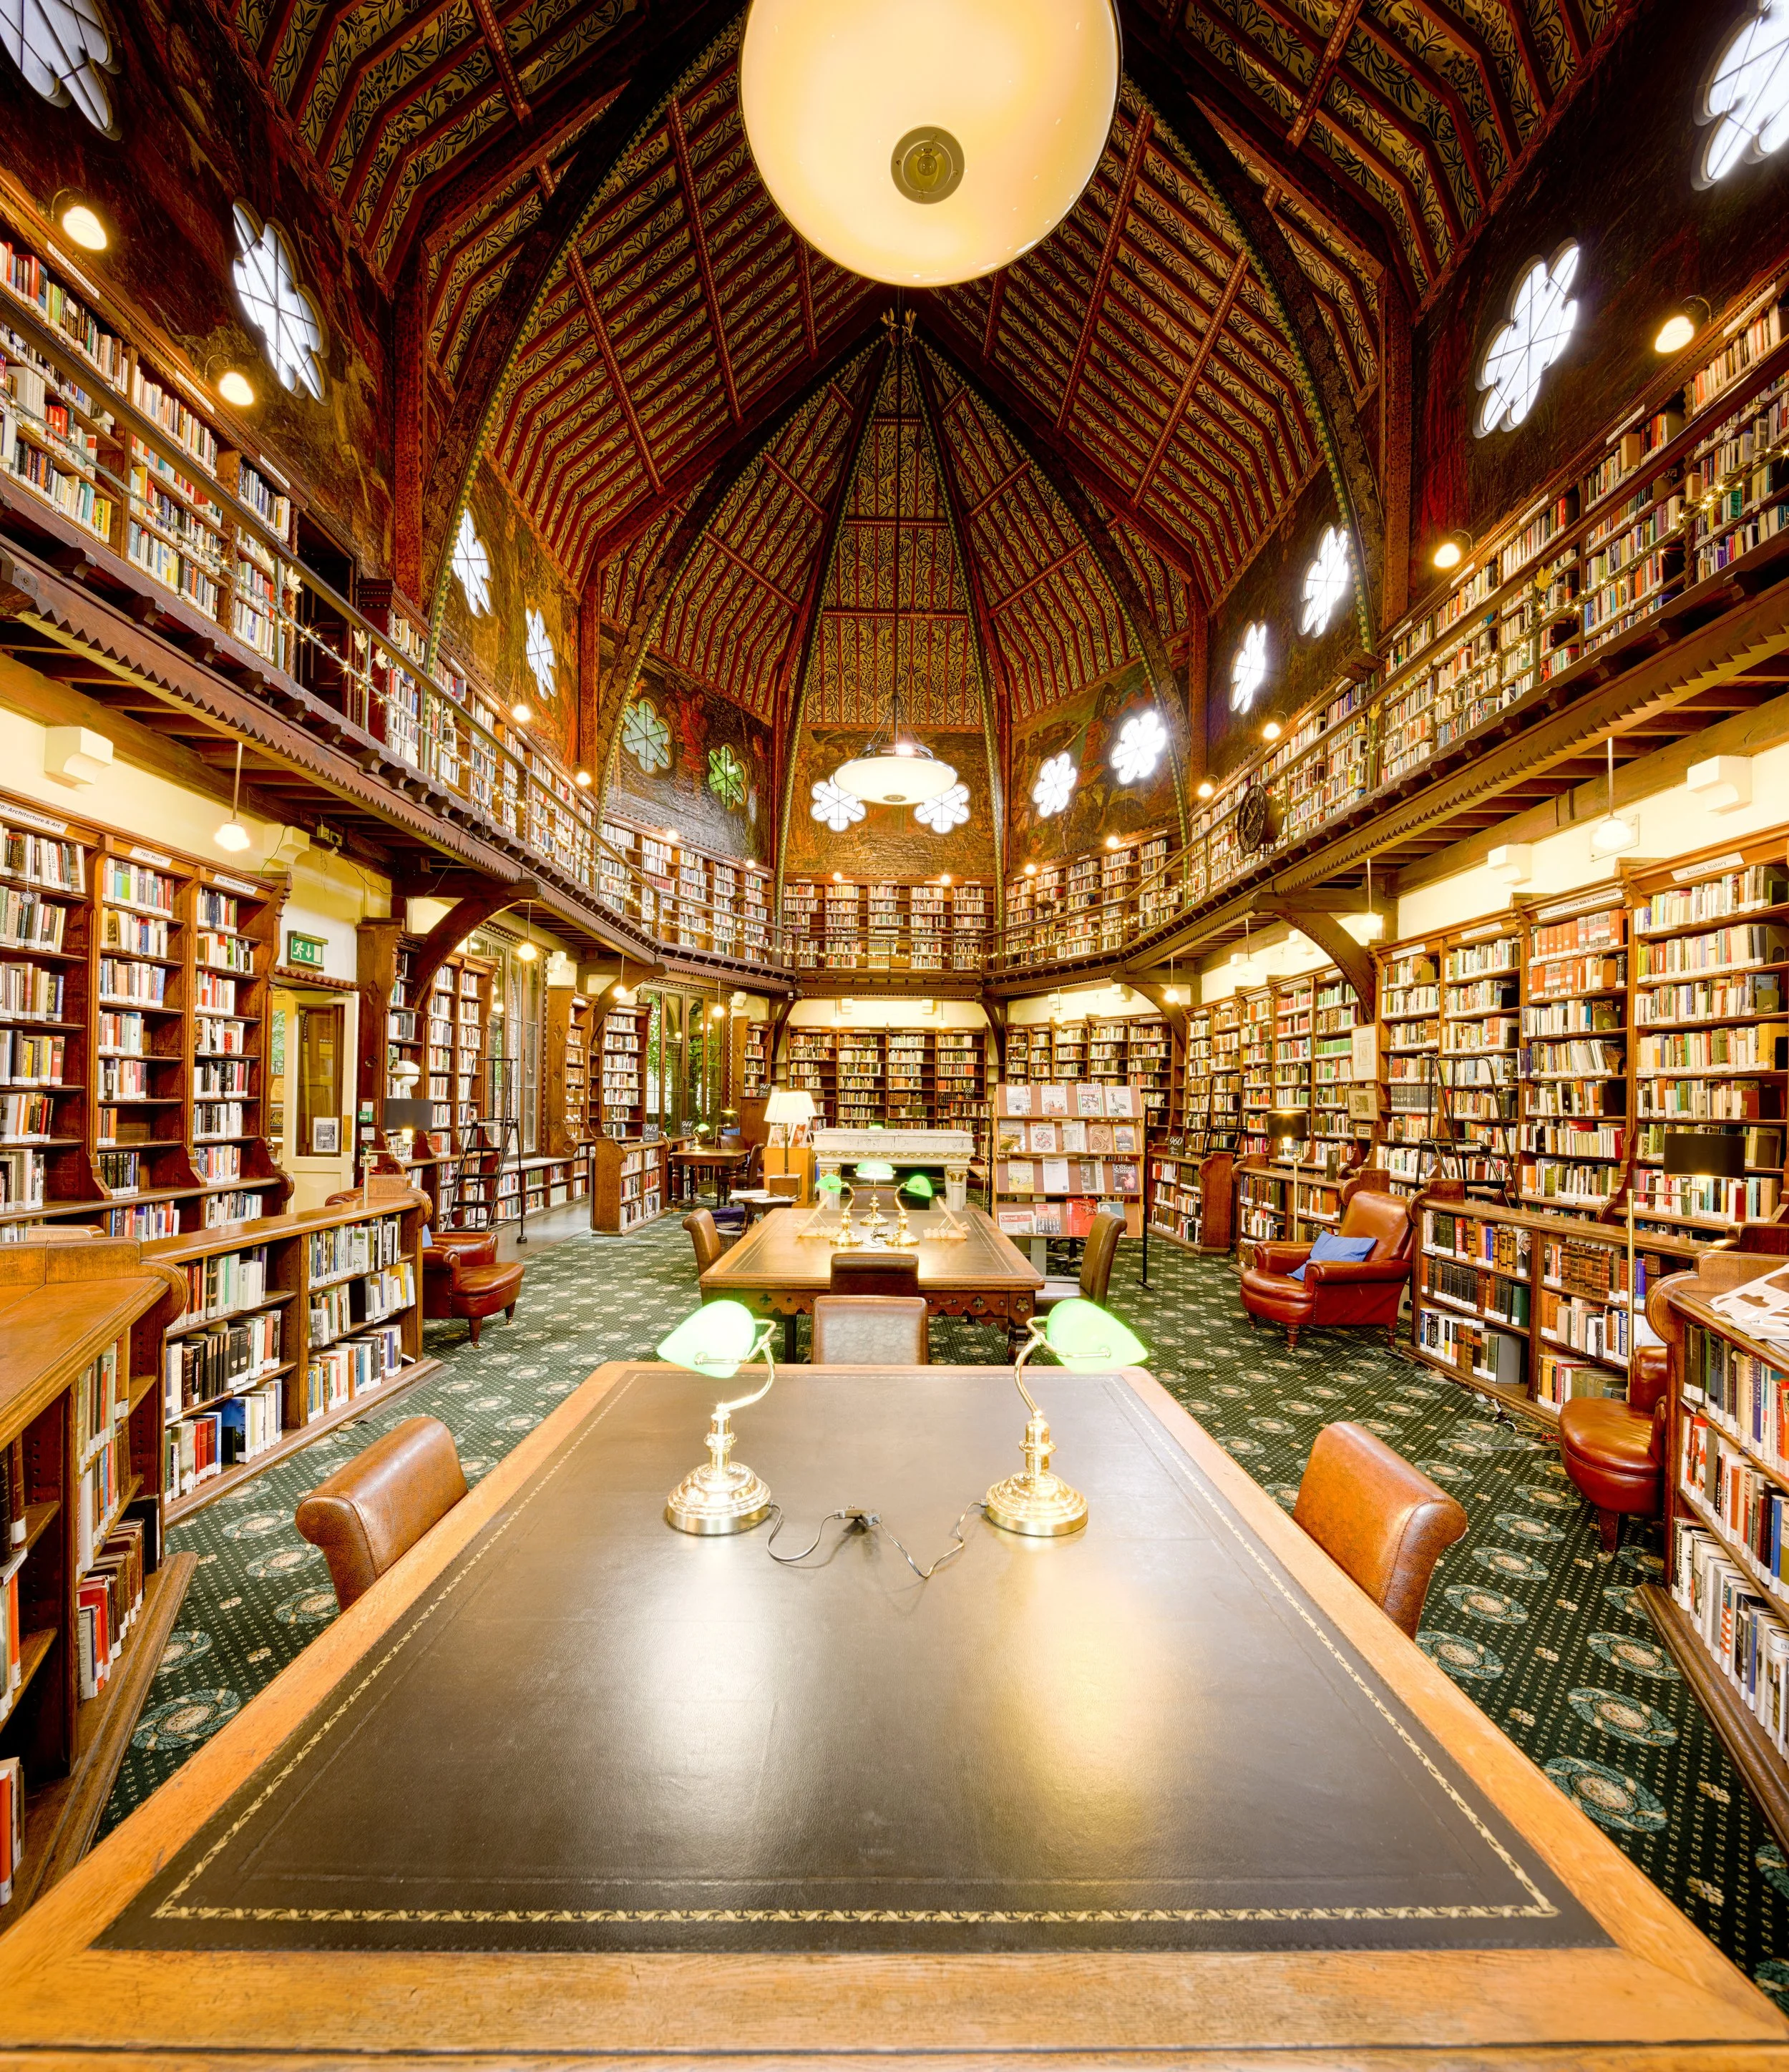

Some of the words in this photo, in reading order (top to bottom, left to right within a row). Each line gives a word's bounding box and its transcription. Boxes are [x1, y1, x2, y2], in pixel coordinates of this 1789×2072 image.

[67, 263, 96, 294] Astronomy
[1739, 300, 1760, 321] Politics
[1617, 418, 1633, 432] Politics
[8, 807, 44, 823] Architecture
[1707, 861, 1727, 869] history
[226, 879, 245, 889] Performing
[1592, 891, 1617, 901] Archaeology
[1169, 1137, 1183, 1145] 960
